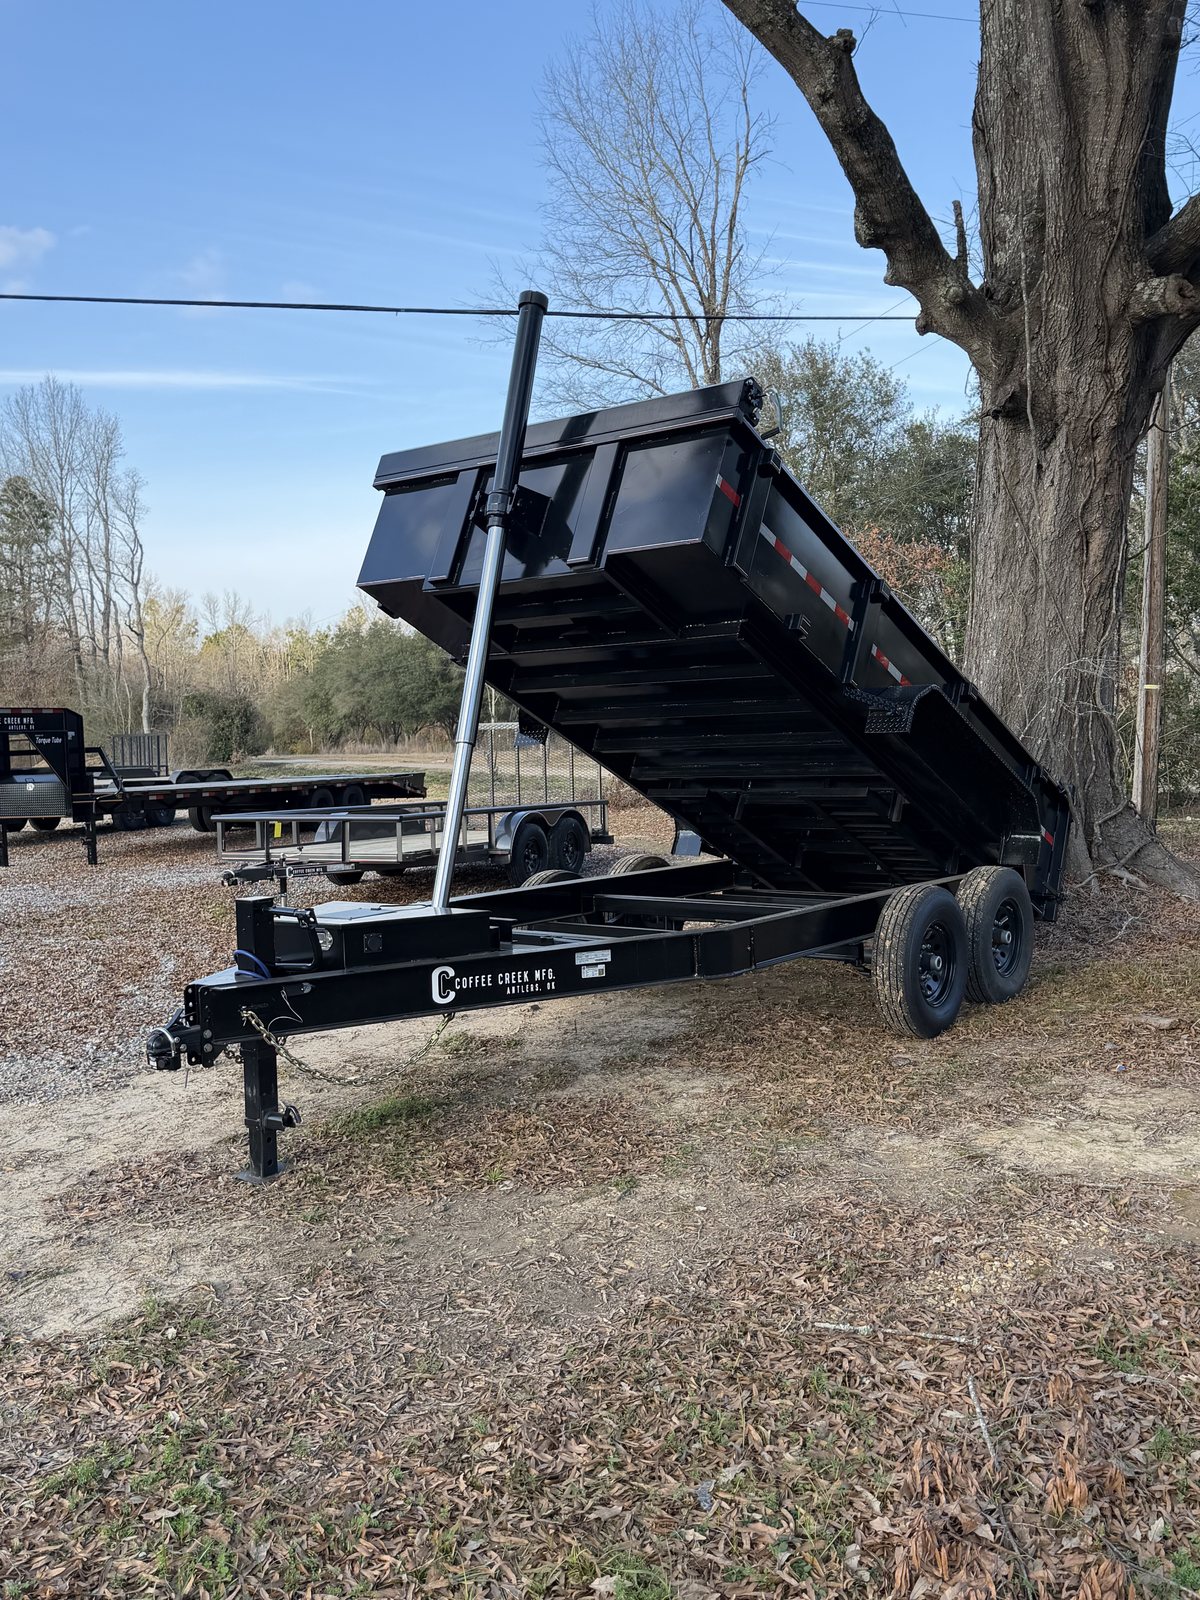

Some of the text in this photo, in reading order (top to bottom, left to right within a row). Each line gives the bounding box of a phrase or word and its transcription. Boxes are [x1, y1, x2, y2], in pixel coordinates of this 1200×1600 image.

[36, 737, 51, 745] Torque
[455, 968, 556, 989] COFFEE CREEK MFG.
[506, 981, 556, 995] ANTLERS, OK
